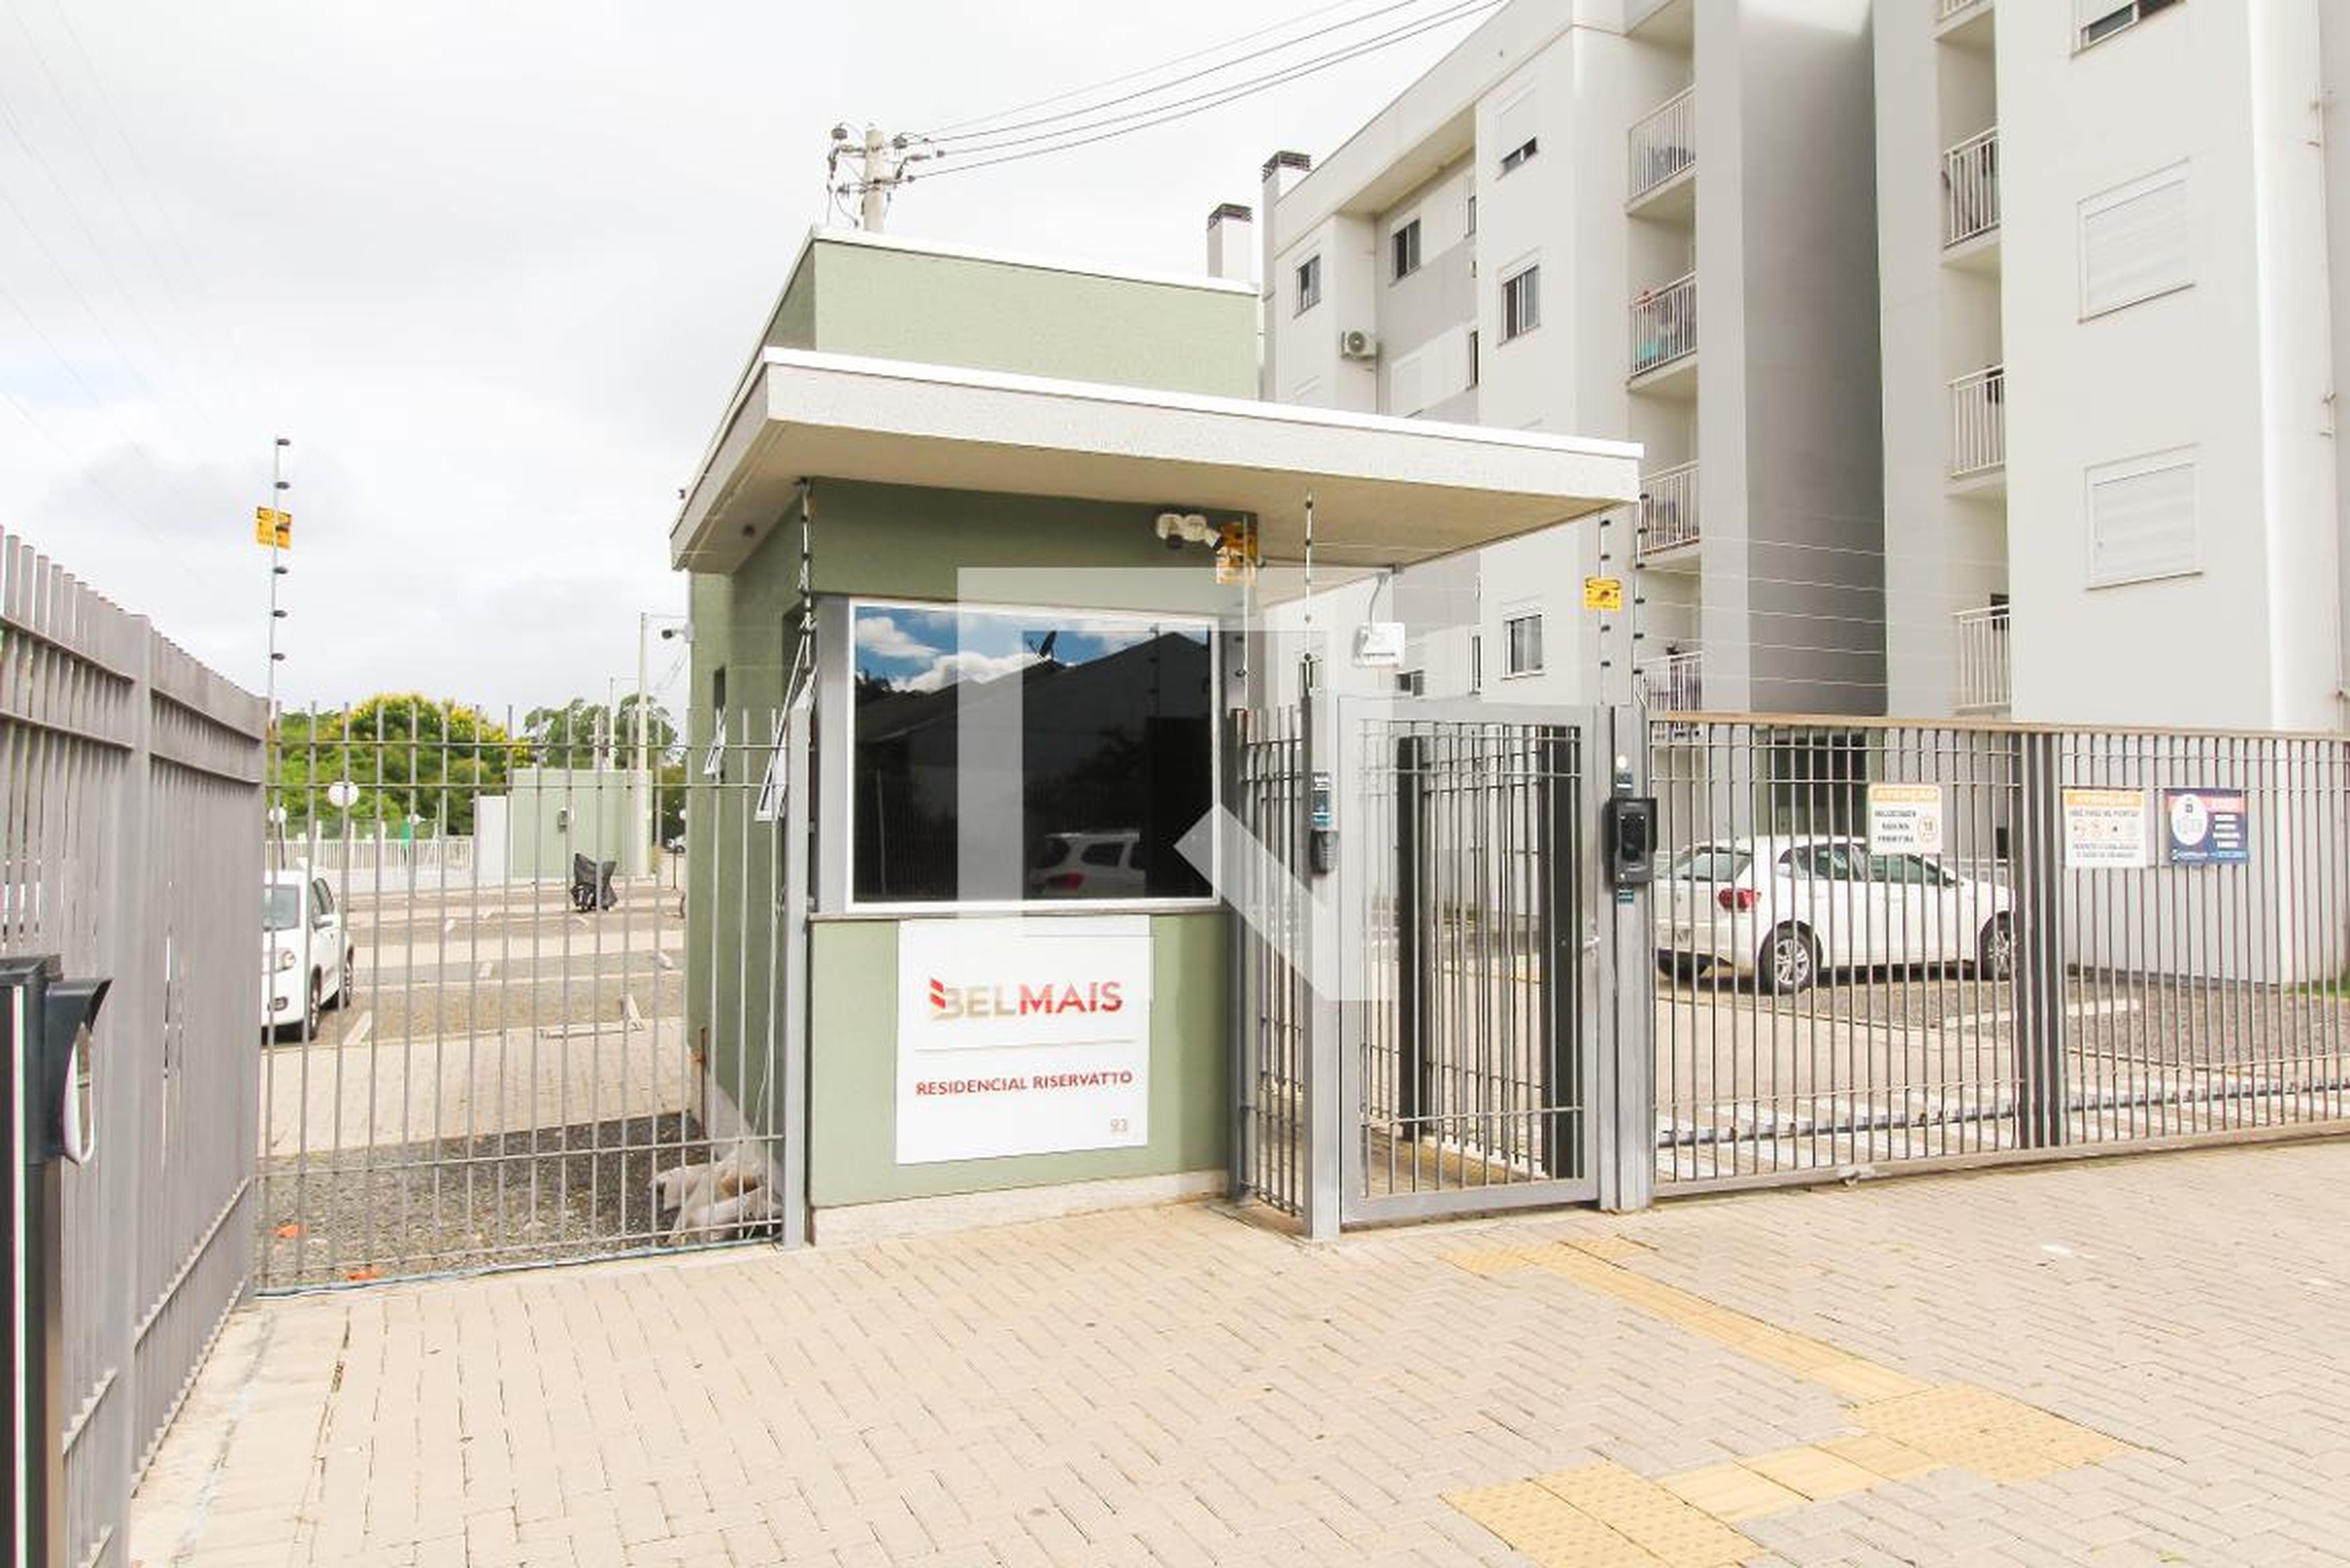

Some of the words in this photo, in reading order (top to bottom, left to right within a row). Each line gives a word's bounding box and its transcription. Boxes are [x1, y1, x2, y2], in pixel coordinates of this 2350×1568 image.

[916, 1078, 1028, 1095] RESIDENCIAL
[1032, 1071, 1133, 1089] RISERVATTO
[1110, 1119, 1128, 1132] 93
